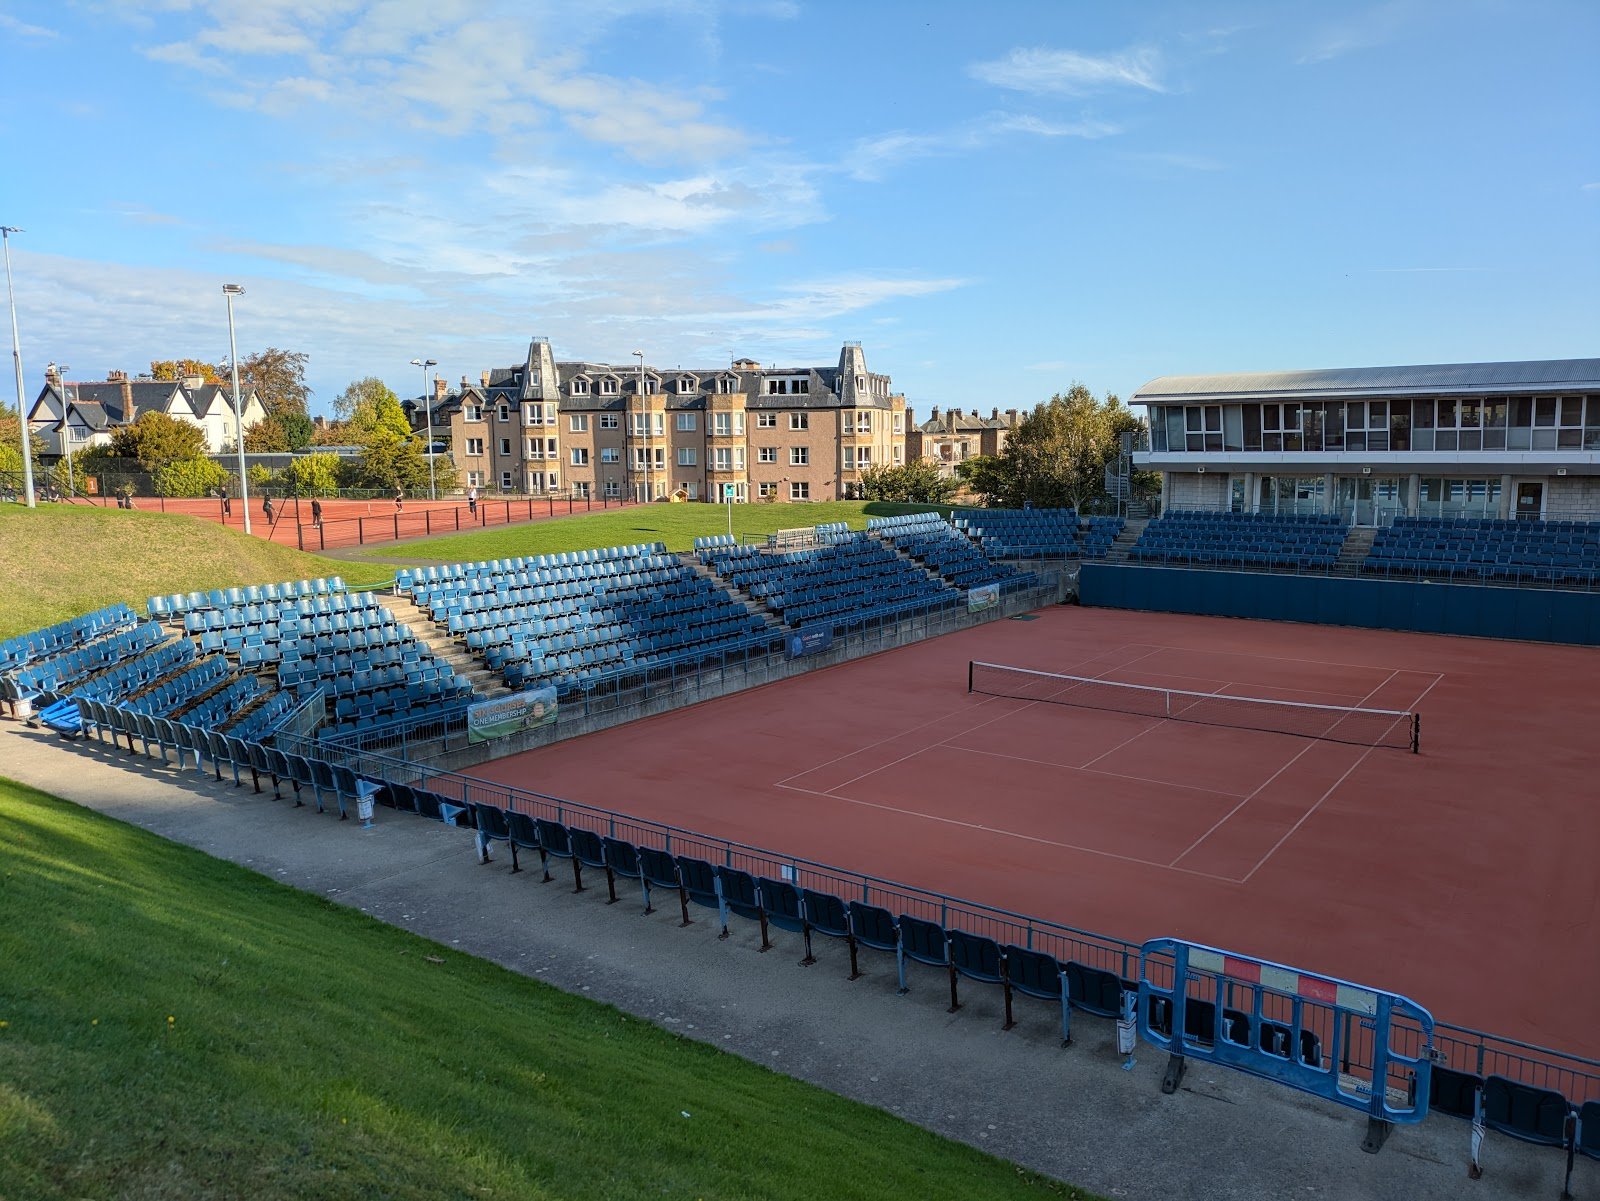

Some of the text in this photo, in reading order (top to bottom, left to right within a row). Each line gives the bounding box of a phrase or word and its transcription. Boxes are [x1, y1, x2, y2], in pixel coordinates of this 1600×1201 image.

[89, 480, 96, 489] 1
[473, 717, 488, 726] ONE
[489, 708, 527, 722] MEMBERSHIP
[474, 708, 487, 718] SIX
